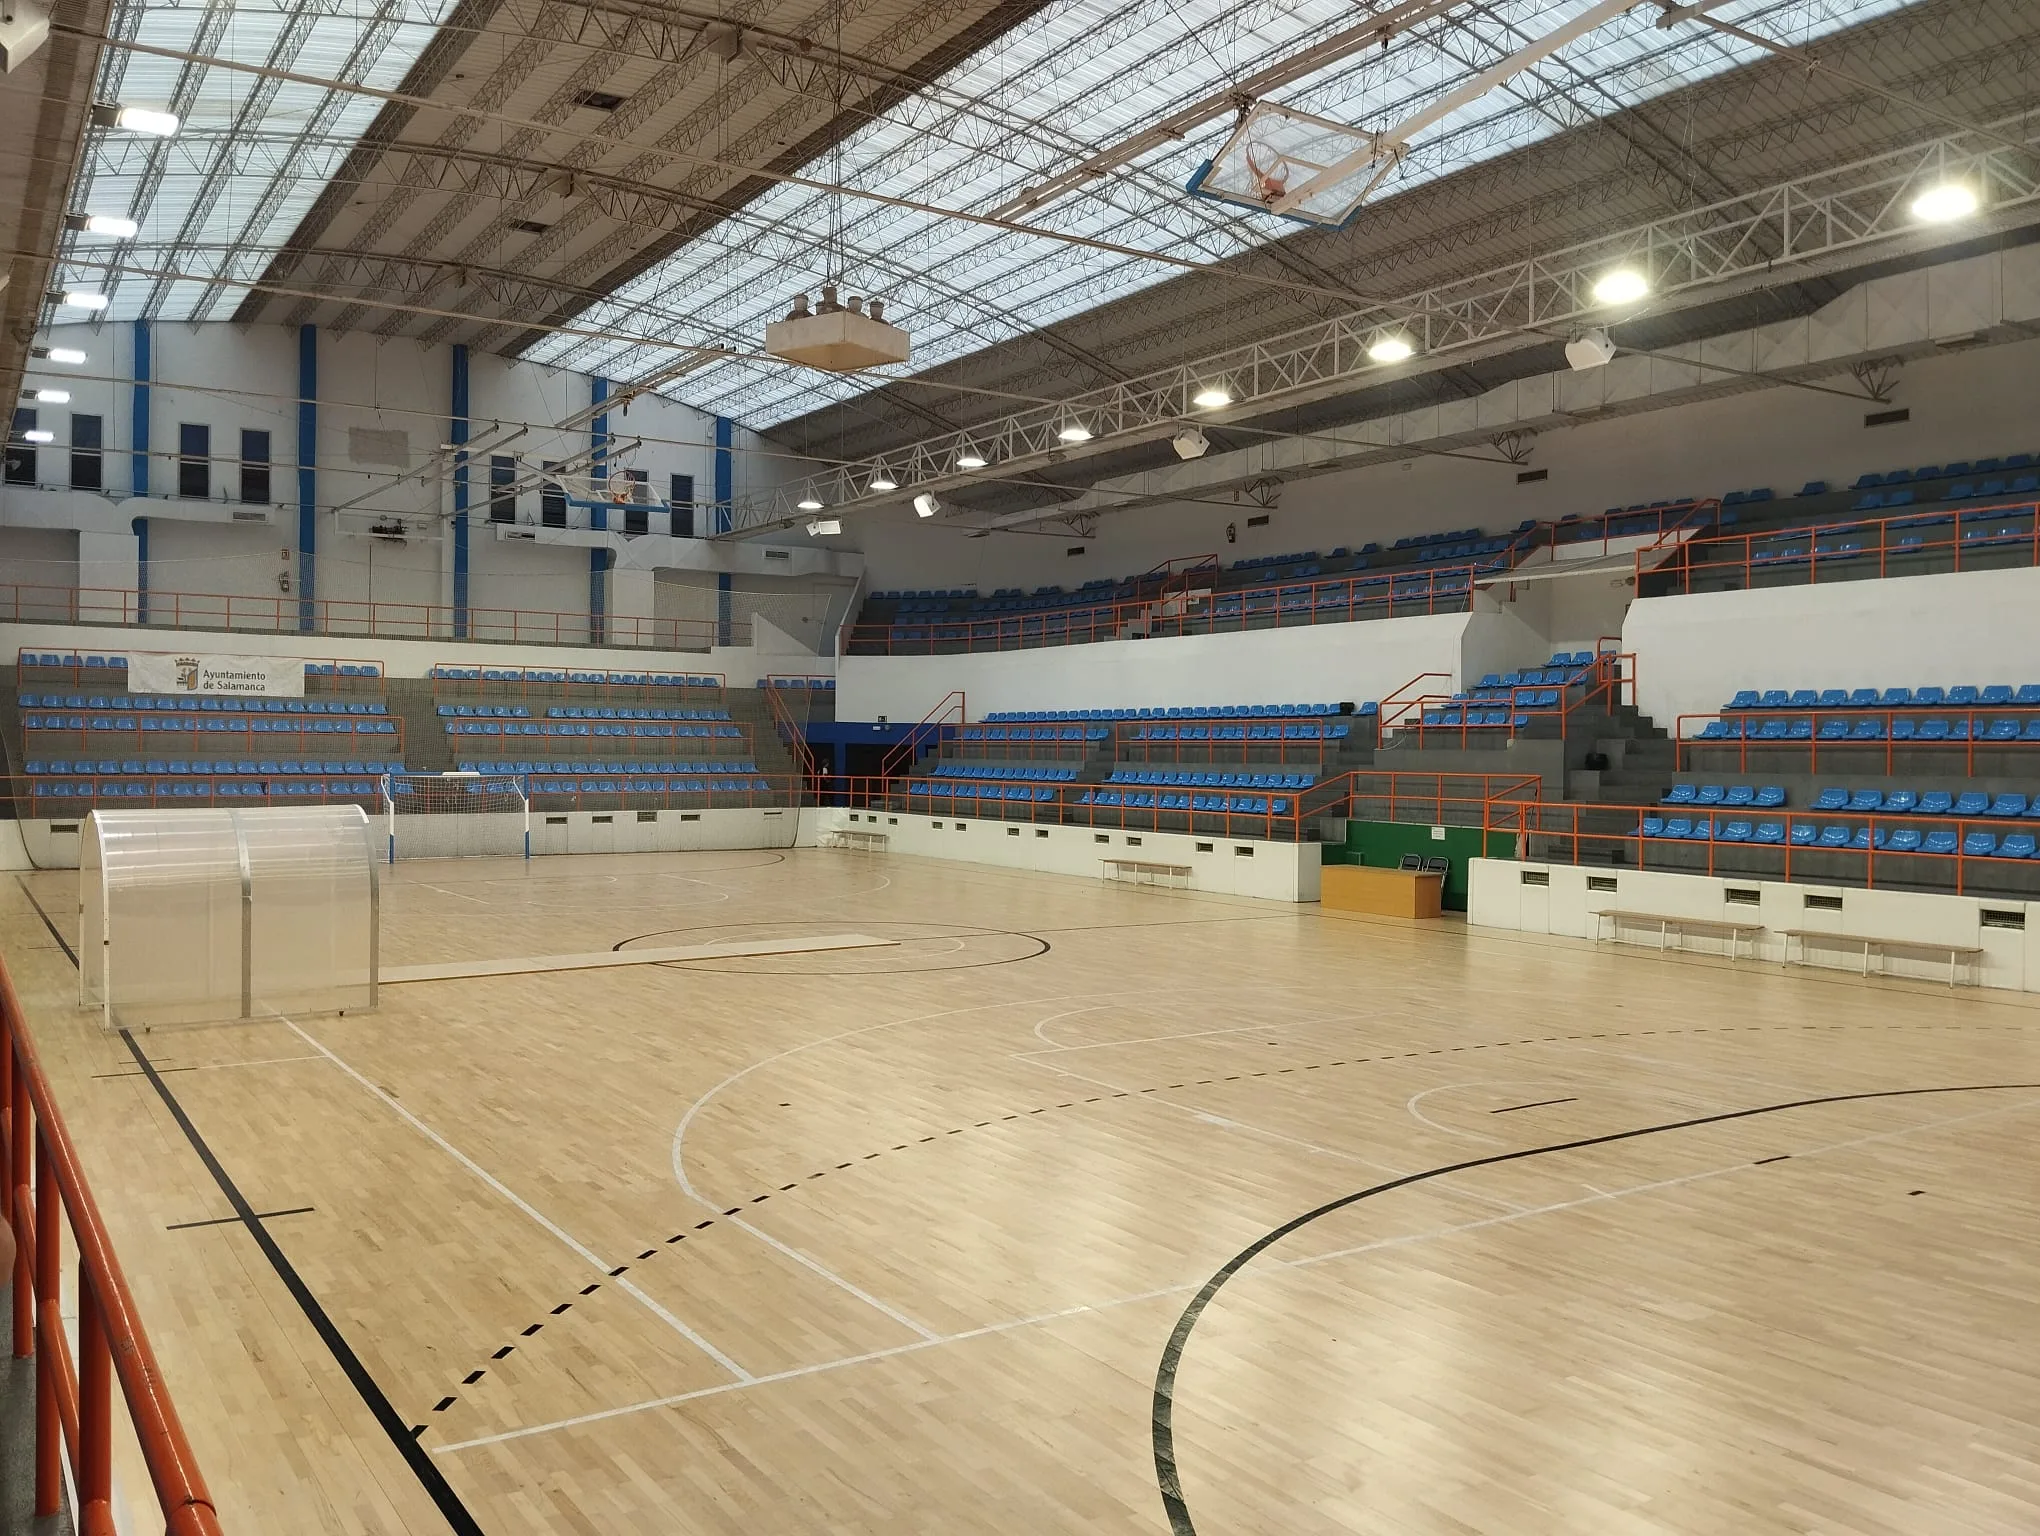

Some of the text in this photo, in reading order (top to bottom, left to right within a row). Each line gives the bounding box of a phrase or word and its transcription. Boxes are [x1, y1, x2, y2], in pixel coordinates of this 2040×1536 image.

[203, 669, 266, 681] Ayuntamiento
[203, 680, 266, 691] de Salamanca
